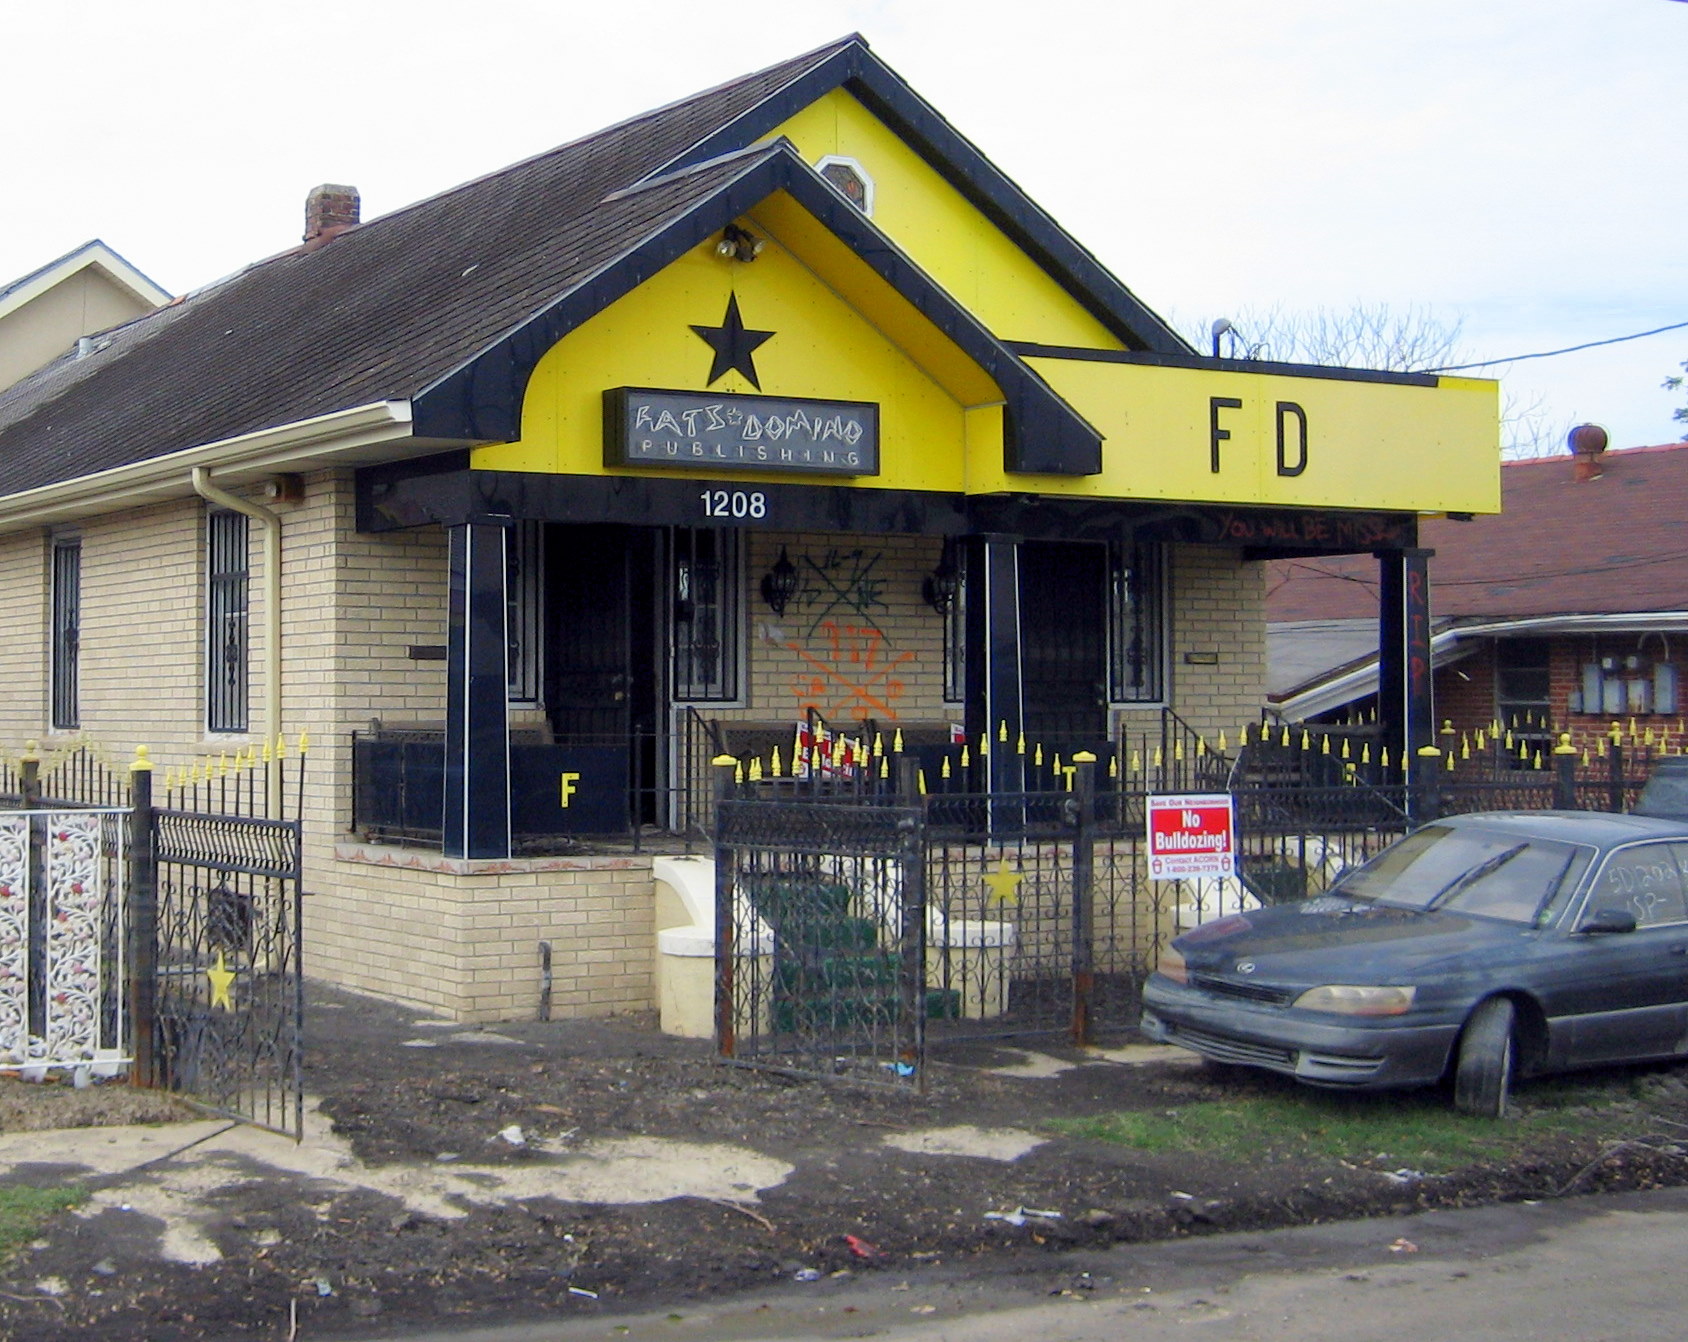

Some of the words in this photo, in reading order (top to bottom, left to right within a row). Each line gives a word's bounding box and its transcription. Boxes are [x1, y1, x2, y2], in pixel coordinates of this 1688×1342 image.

[635, 404, 727, 437] FATS
[742, 409, 863, 445] DOMINO
[1210, 396, 1242, 473] F
[1276, 401, 1307, 476] D
[642, 440, 859, 465] PUBLISHING
[700, 490, 767, 519] 1208
[561, 772, 580, 808] F
[1182, 809, 1201, 828] No
[1155, 830, 1227, 852] Bulldozing!
